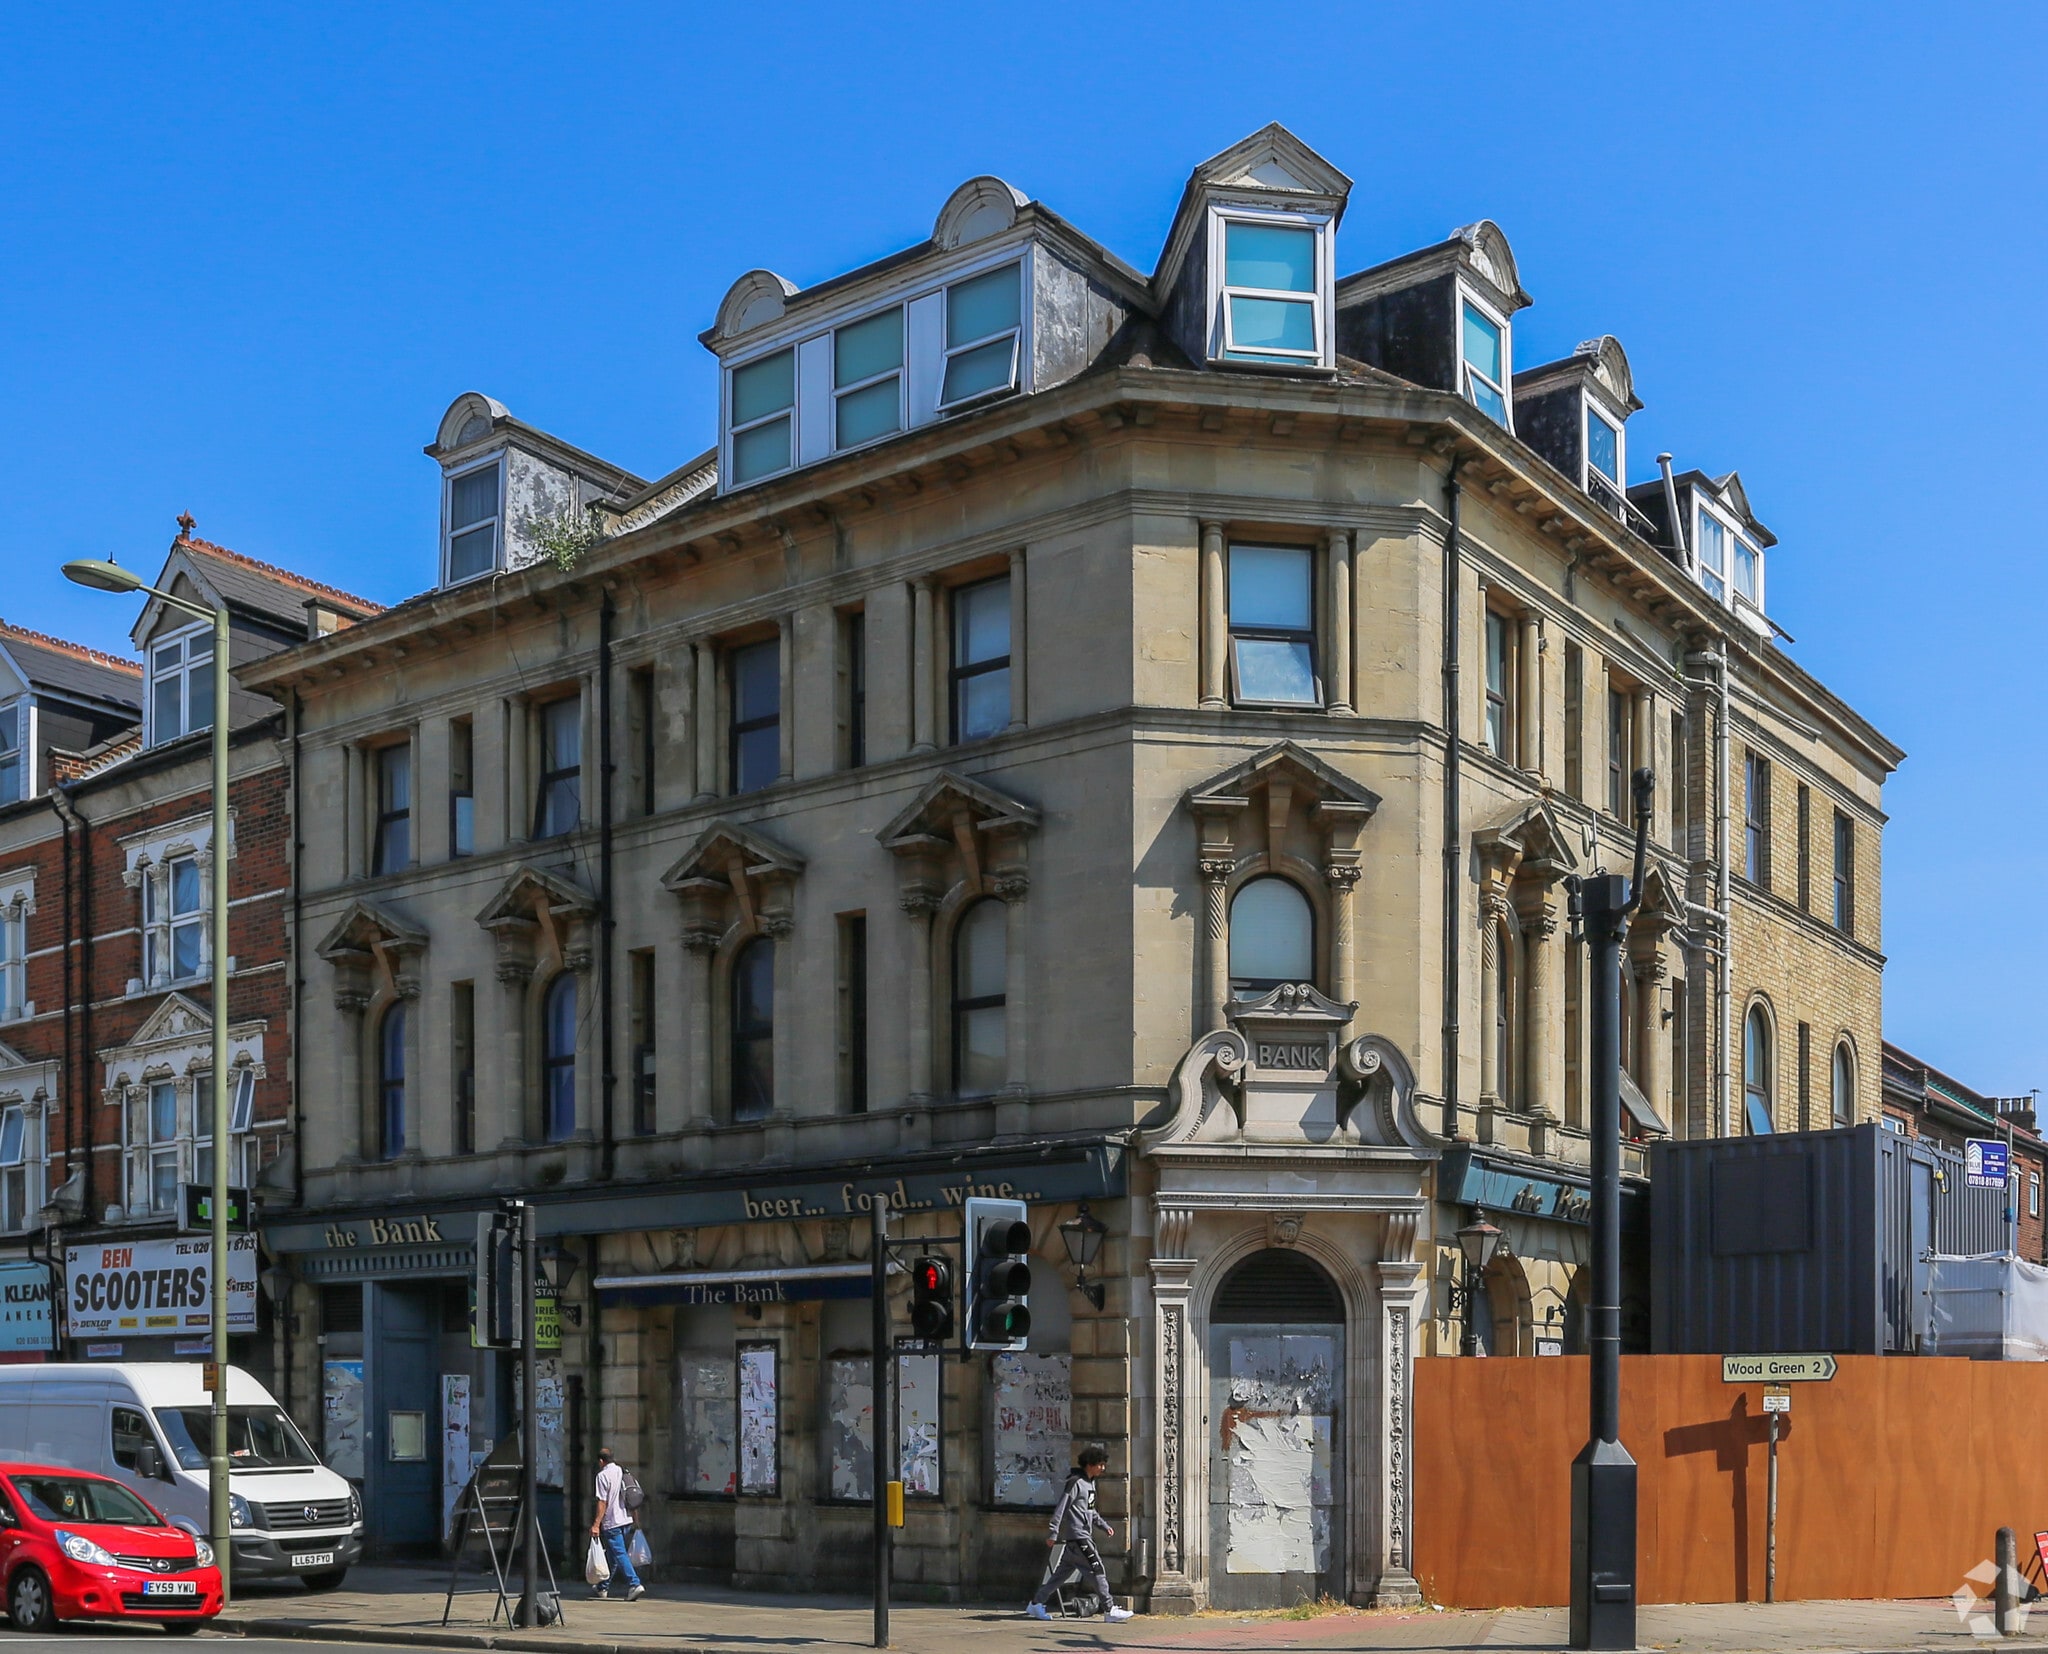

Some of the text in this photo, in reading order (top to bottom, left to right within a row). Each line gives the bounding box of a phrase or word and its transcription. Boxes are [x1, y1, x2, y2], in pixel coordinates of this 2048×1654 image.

[1260, 1045, 1321, 1067] BANK
[741, 1174, 1041, 1219] beer... food... wine...
[1513, 1182, 1592, 1222] the Ban
[325, 1215, 442, 1248] the Bank
[68, 1252, 78, 1263] 34
[101, 1248, 133, 1269] BEN
[176, 1244, 191, 1255] TEL:
[193, 1242, 210, 1254] 020
[5, 1283, 51, 1303] KLEAN
[74, 1266, 207, 1313] SCOOTERS
[684, 1281, 786, 1305] The Bank
[80, 1319, 112, 1328] DUNLOP
[537, 1324, 560, 1338] 400
[1727, 1361, 1821, 1375] Wood Green 2
[295, 1555, 315, 1565] LL63
[148, 1582, 195, 1593] EY59 YWU
